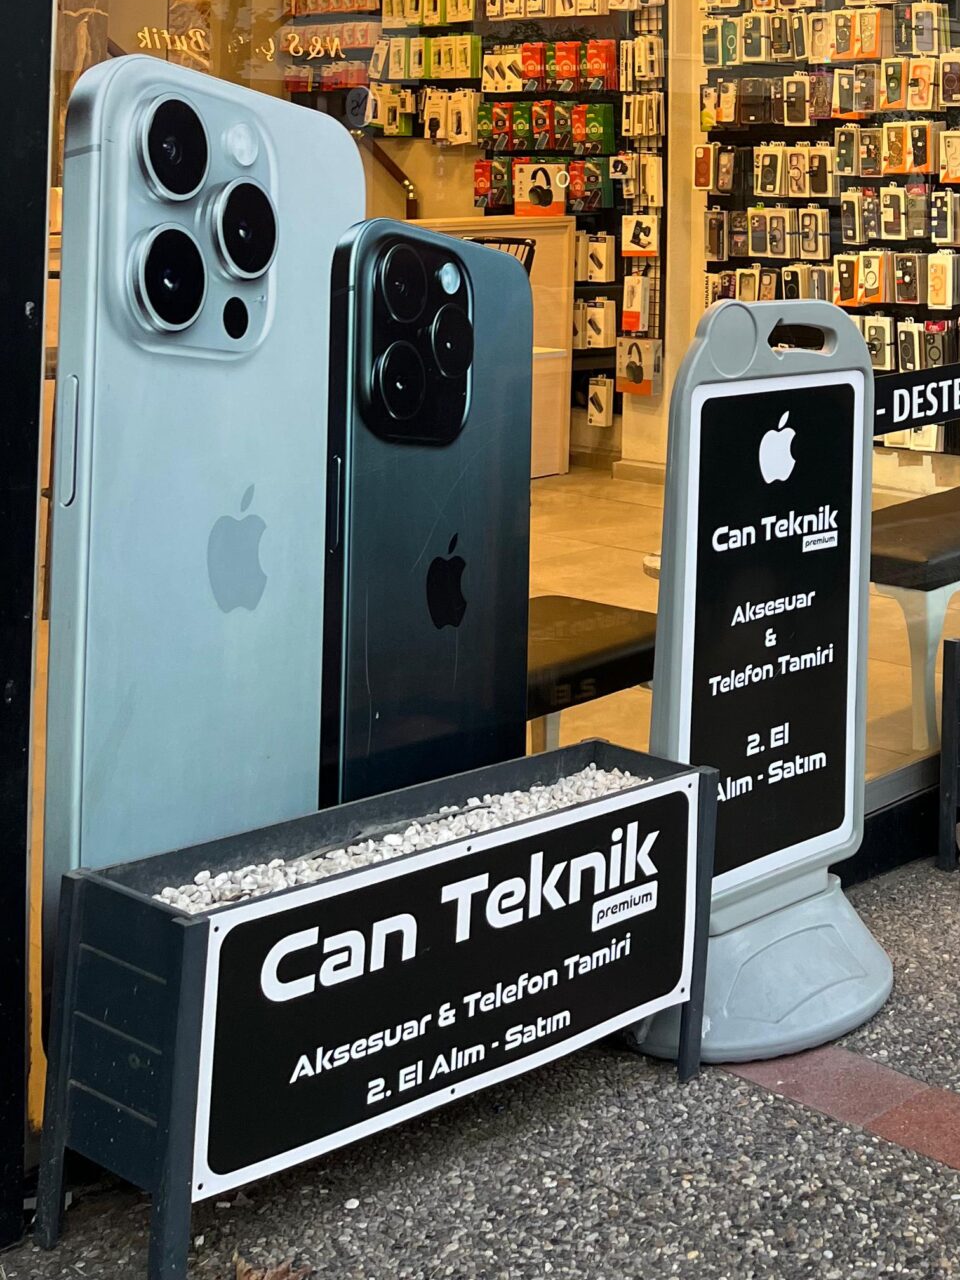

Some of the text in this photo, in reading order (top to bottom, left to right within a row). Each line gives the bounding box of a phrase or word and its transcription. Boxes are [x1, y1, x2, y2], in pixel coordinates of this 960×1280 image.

[711, 504, 839, 552] Can Teknik
[804, 536, 836, 549] premium
[730, 590, 816, 627] Aksesuar
[764, 628, 777, 648] &
[708, 642, 834, 697] Telefon Tamiri
[746, 722, 790, 757] 2. El
[716, 775, 753, 802] Alım
[768, 751, 827, 785] Satım
[260, 820, 661, 1003] Can Teknik
[596, 890, 654, 926] premium
[288, 932, 632, 1085] Aksesuar & Telefon Tamiri
[366, 1077, 392, 1106] 2.
[398, 1064, 424, 1093] El
[428, 1041, 486, 1082] Alım
[503, 1008, 572, 1053] Satım
